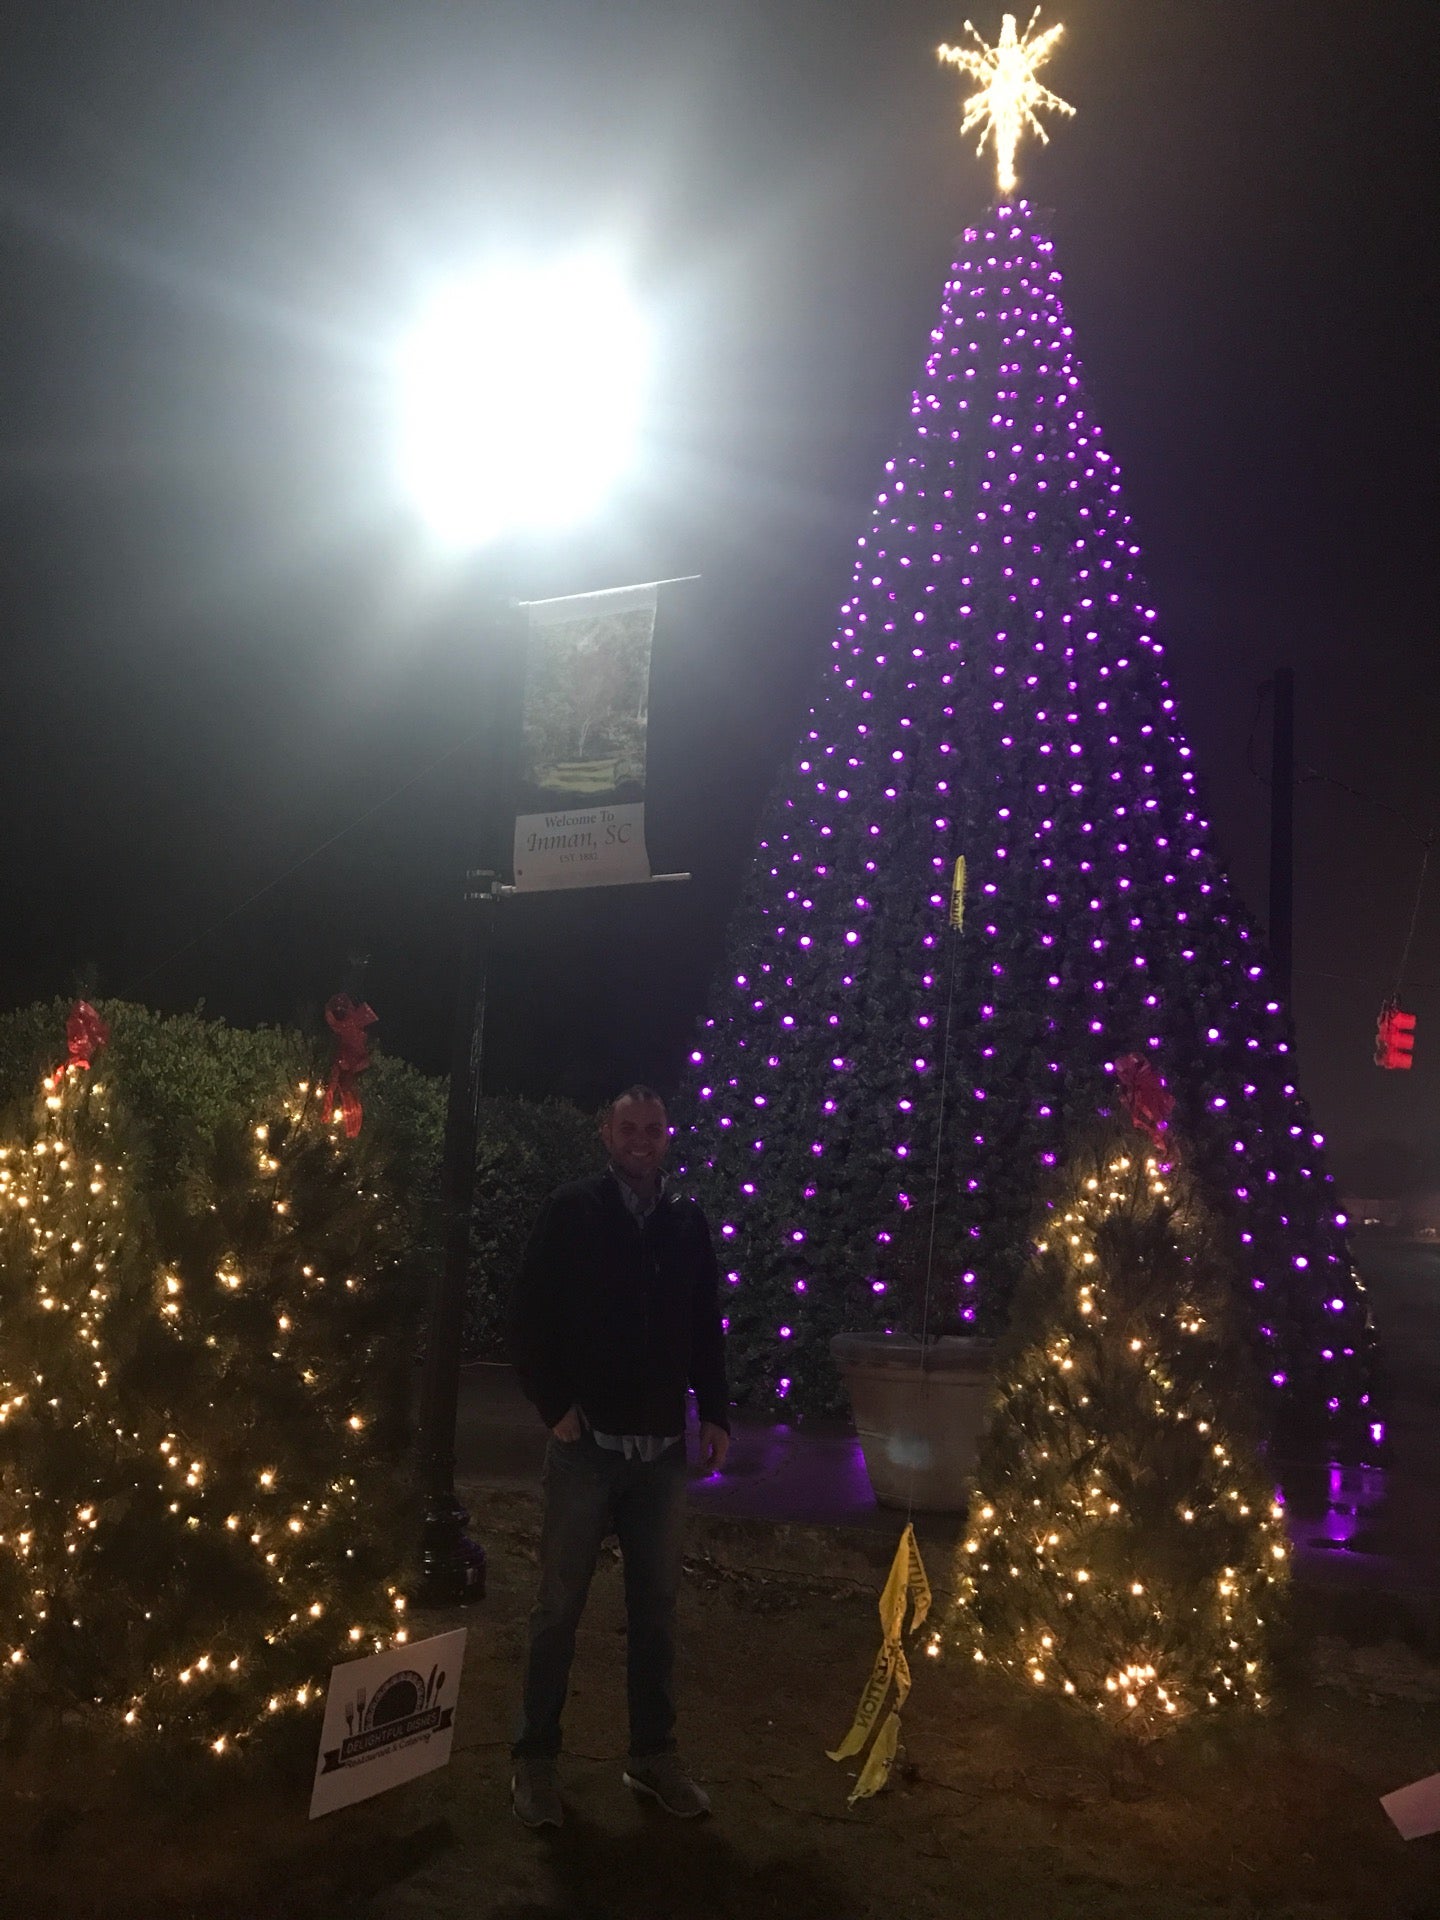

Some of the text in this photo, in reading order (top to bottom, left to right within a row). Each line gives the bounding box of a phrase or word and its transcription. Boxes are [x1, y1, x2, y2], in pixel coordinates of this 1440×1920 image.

[545, 810, 615, 828] Welcome To
[527, 823, 633, 852] Inman, SC
[346, 1711, 439, 1754] DELIGHTFUL DISHES
